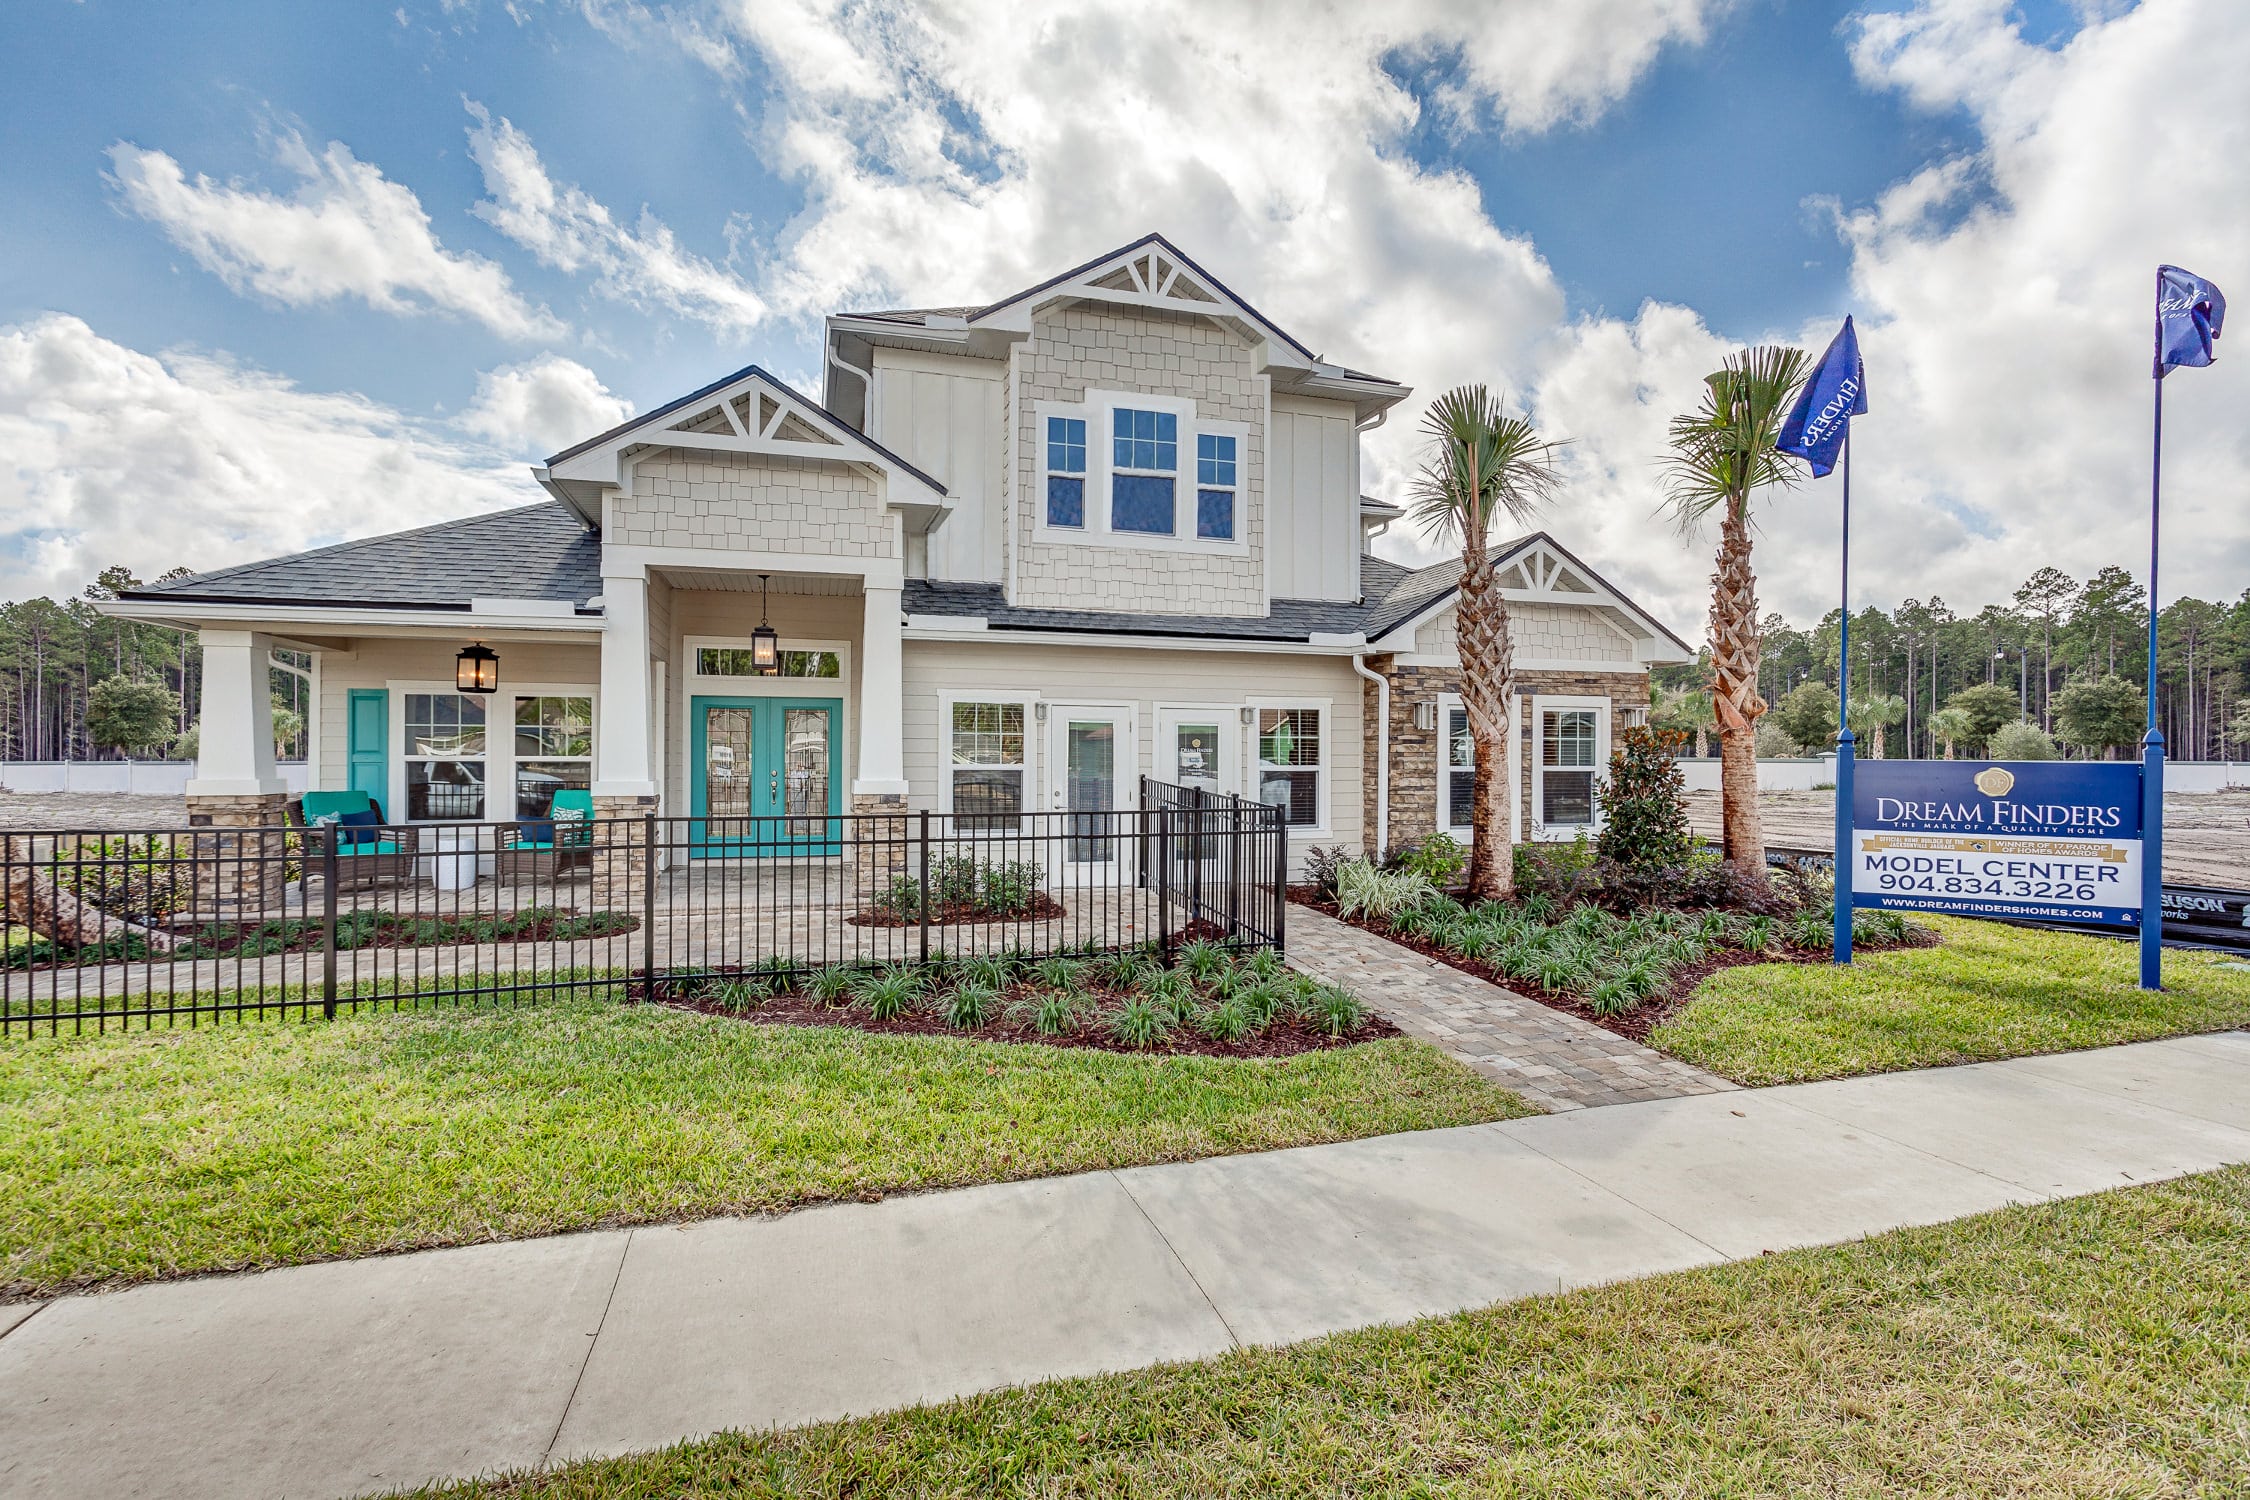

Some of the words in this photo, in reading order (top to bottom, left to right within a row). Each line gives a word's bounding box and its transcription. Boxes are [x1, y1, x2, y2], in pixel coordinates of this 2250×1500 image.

[1876, 798, 1985, 822] DREAM
[1992, 800, 2120, 827] FINDERS
[2001, 825, 2058, 833] QUALITY
[2067, 827, 2105, 835] HOME
[1995, 840, 2034, 849] WINNER
[2066, 844, 2108, 852] PARADE
[2017, 847, 2053, 855] HOMES
[2055, 849, 2099, 857] AWARDS
[1865, 855, 1975, 875] MODEL
[1982, 860, 2120, 883] CENTER
[1879, 873, 2096, 901] 904.834.3226
[1882, 898, 2103, 919] WWW.DREAMFINDERSHOMES.COM
